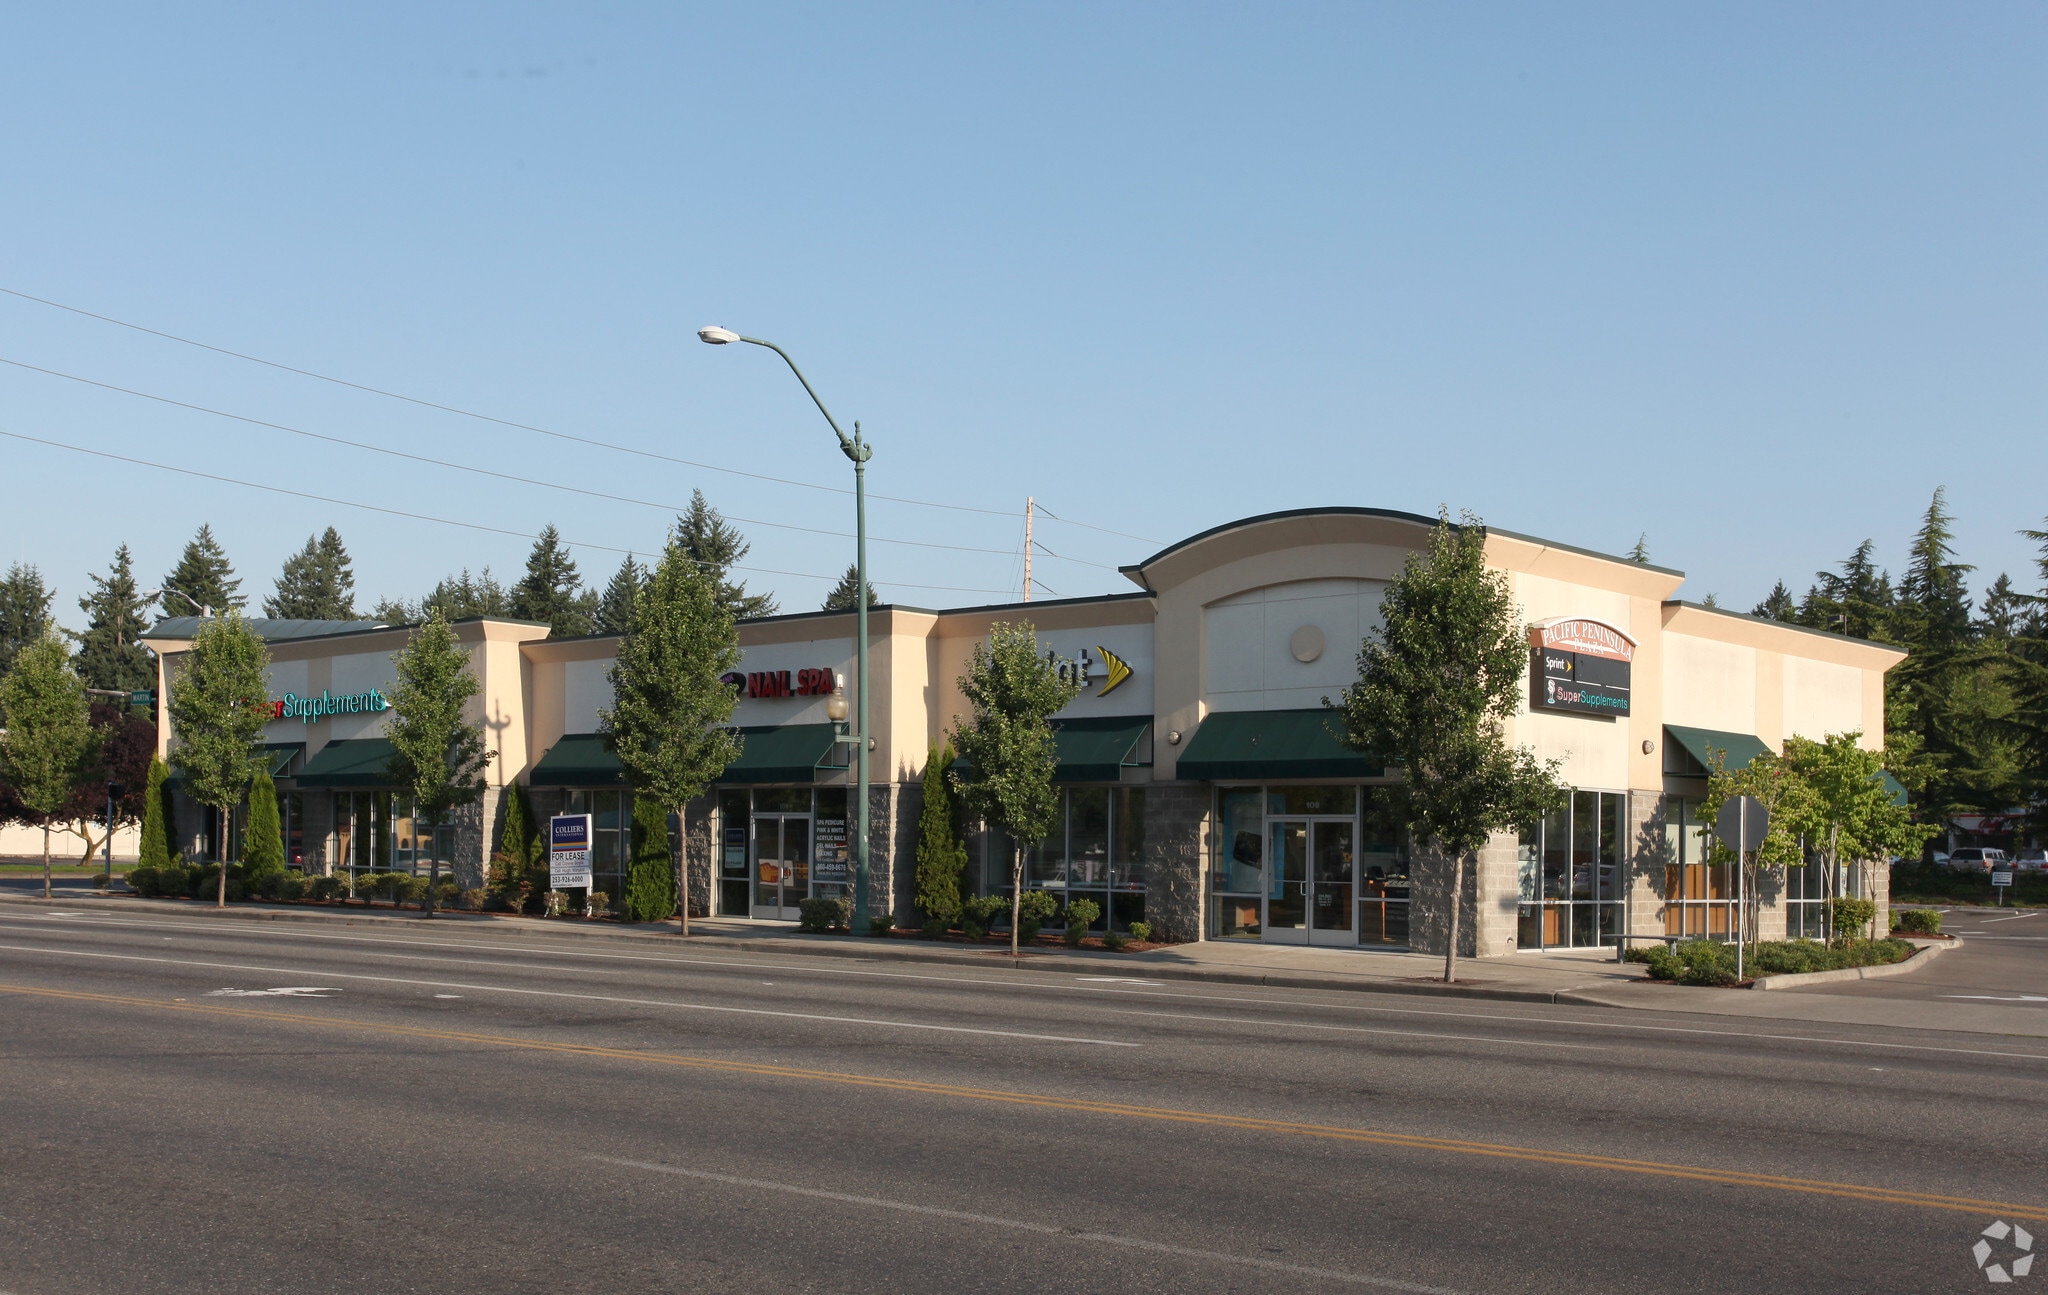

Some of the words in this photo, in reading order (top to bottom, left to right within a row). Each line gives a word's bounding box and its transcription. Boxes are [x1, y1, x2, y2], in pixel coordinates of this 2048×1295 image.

[1542, 621, 1581, 646] PACIFIC
[1582, 621, 1632, 661] PENINSULA
[1574, 638, 1605, 655] PLAZA
[1546, 656, 1565, 671] Sprint
[748, 670, 793, 698] NAIL
[797, 667, 835, 696] SPA
[132, 694, 150, 702] MARTIN
[1557, 687, 1628, 710] SuperSupplements
[555, 825, 585, 834] COLLIERS
[552, 852, 564, 861] FOR
[565, 852, 585, 861] LEASE
